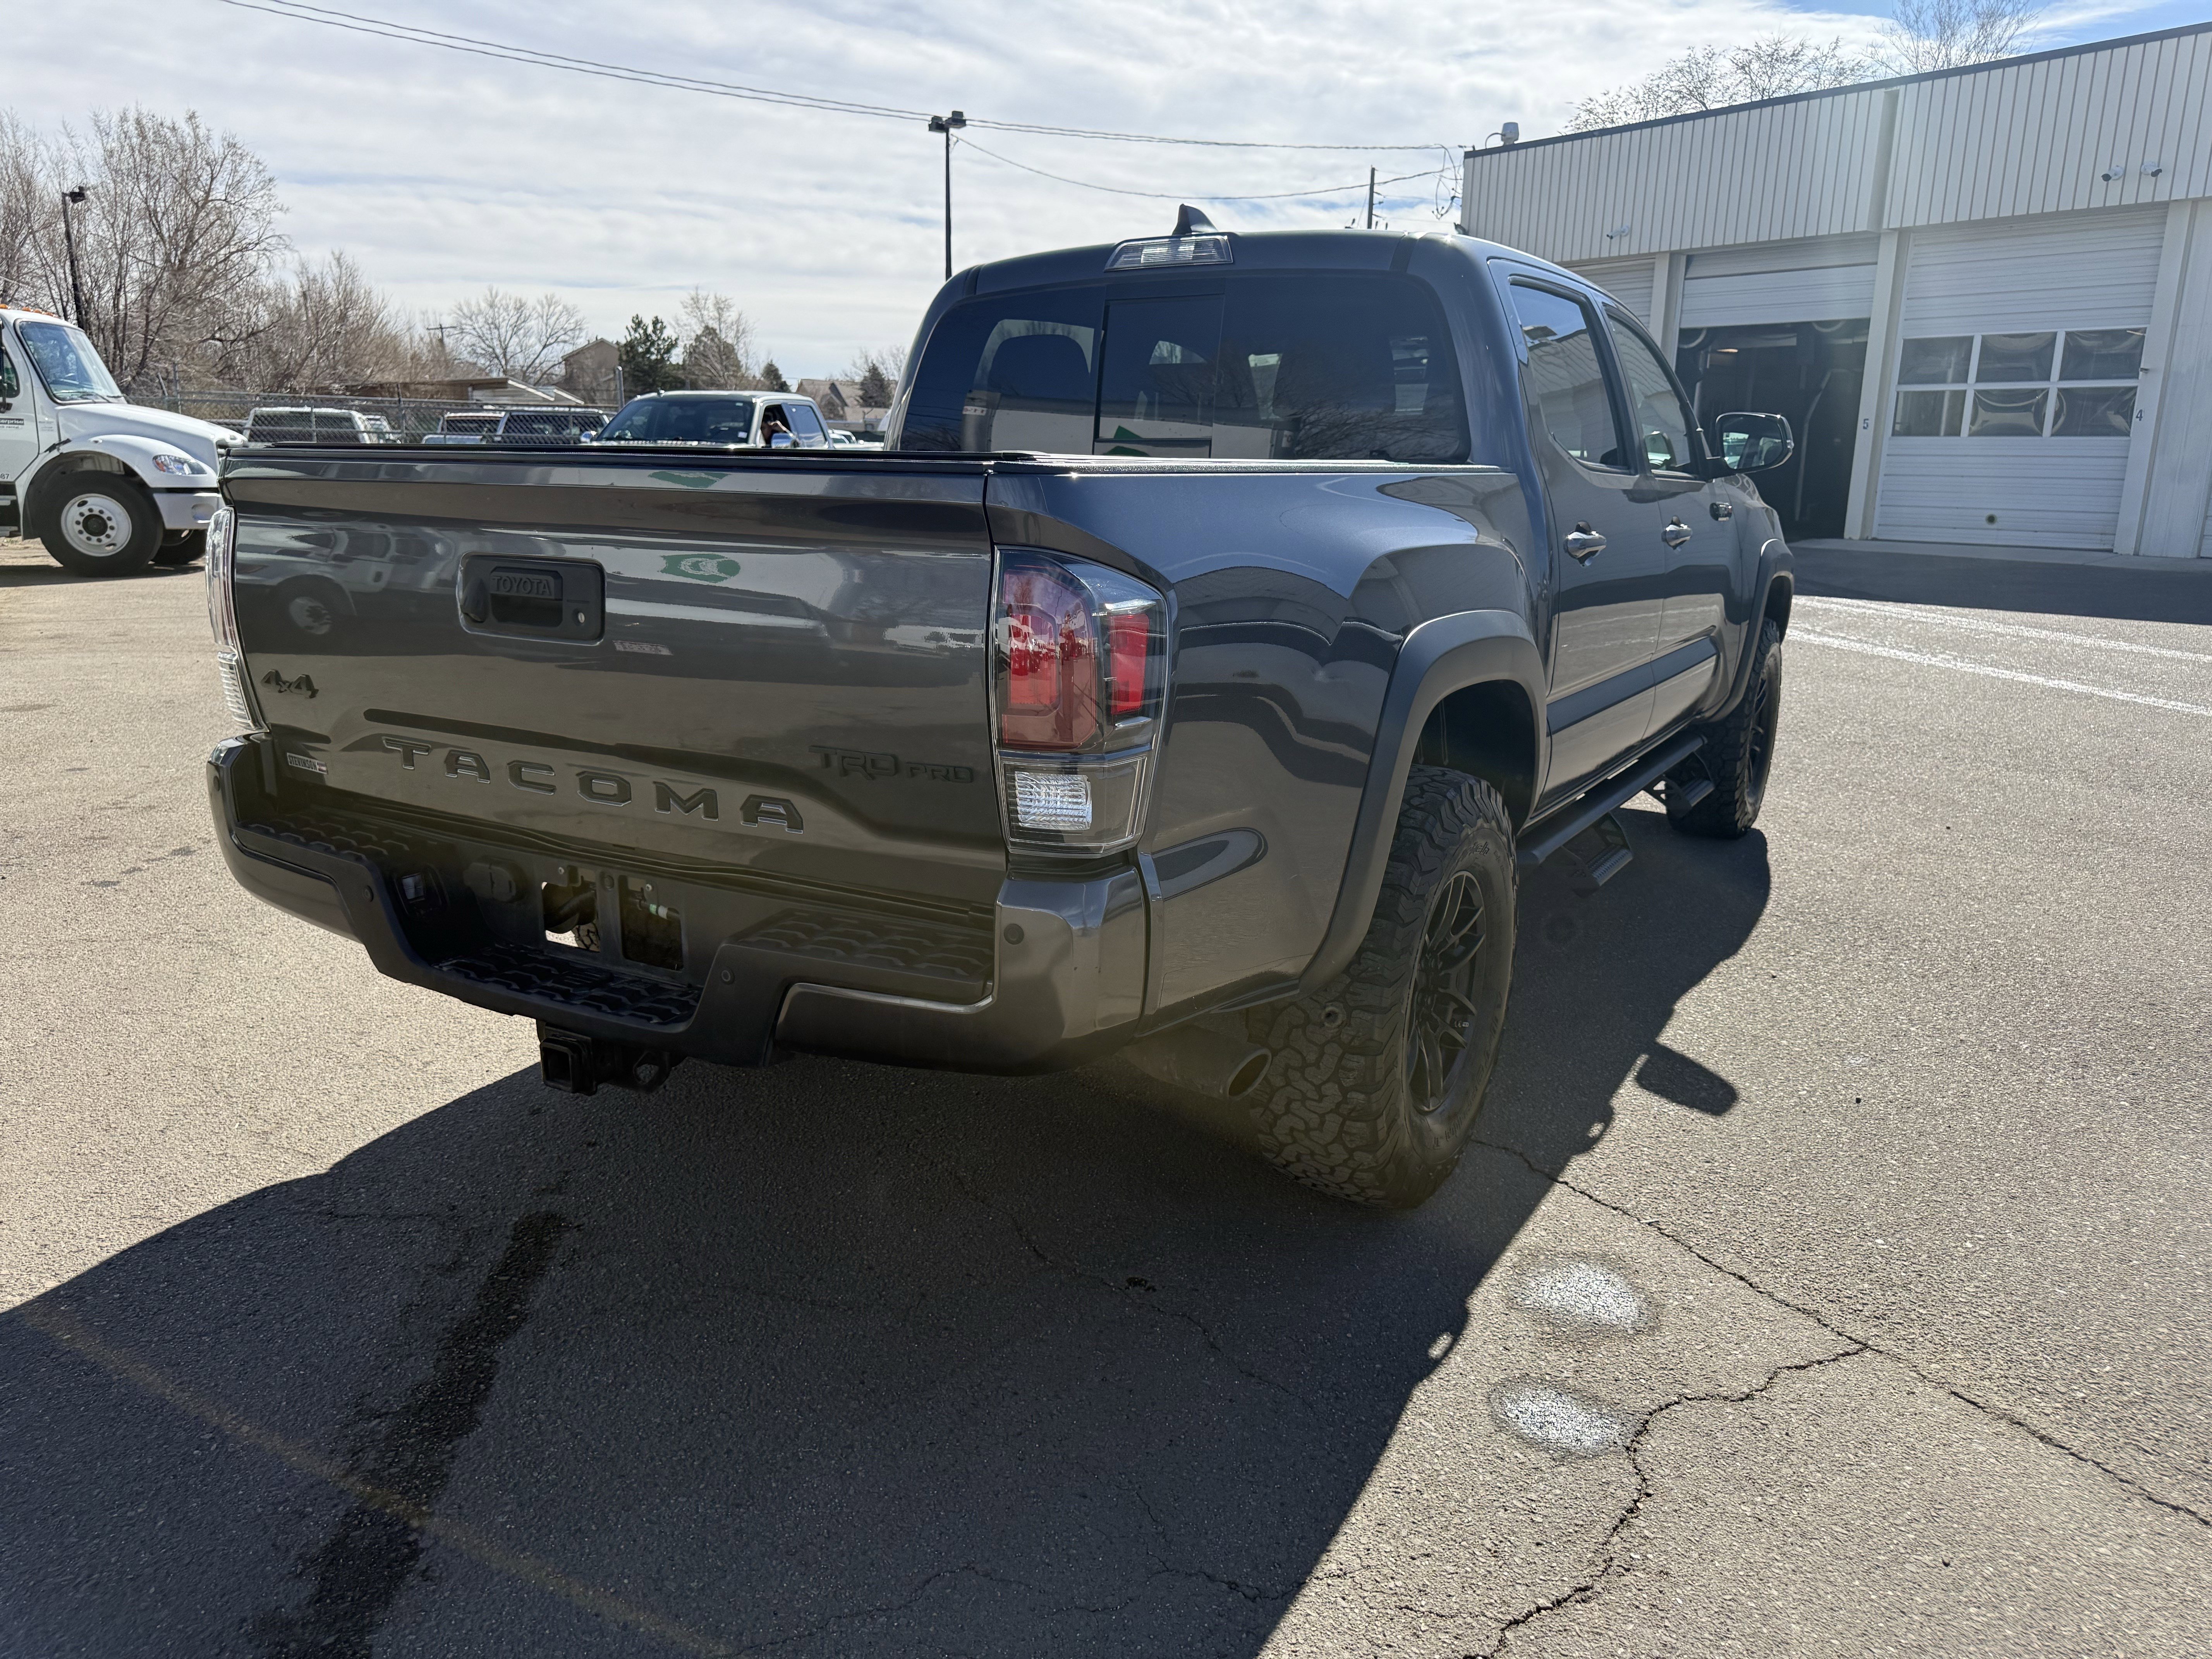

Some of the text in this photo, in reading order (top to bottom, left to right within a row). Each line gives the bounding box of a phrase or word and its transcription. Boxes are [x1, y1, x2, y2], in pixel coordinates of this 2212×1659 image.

[1863, 418, 1869, 429] 5
[2136, 409, 2143, 421] 4
[491, 575, 553, 596] TOYOTA
[288, 754, 318, 771] STEVINSON
[808, 745, 974, 784] TRD PRO
[381, 736, 803, 834] TACOMA
